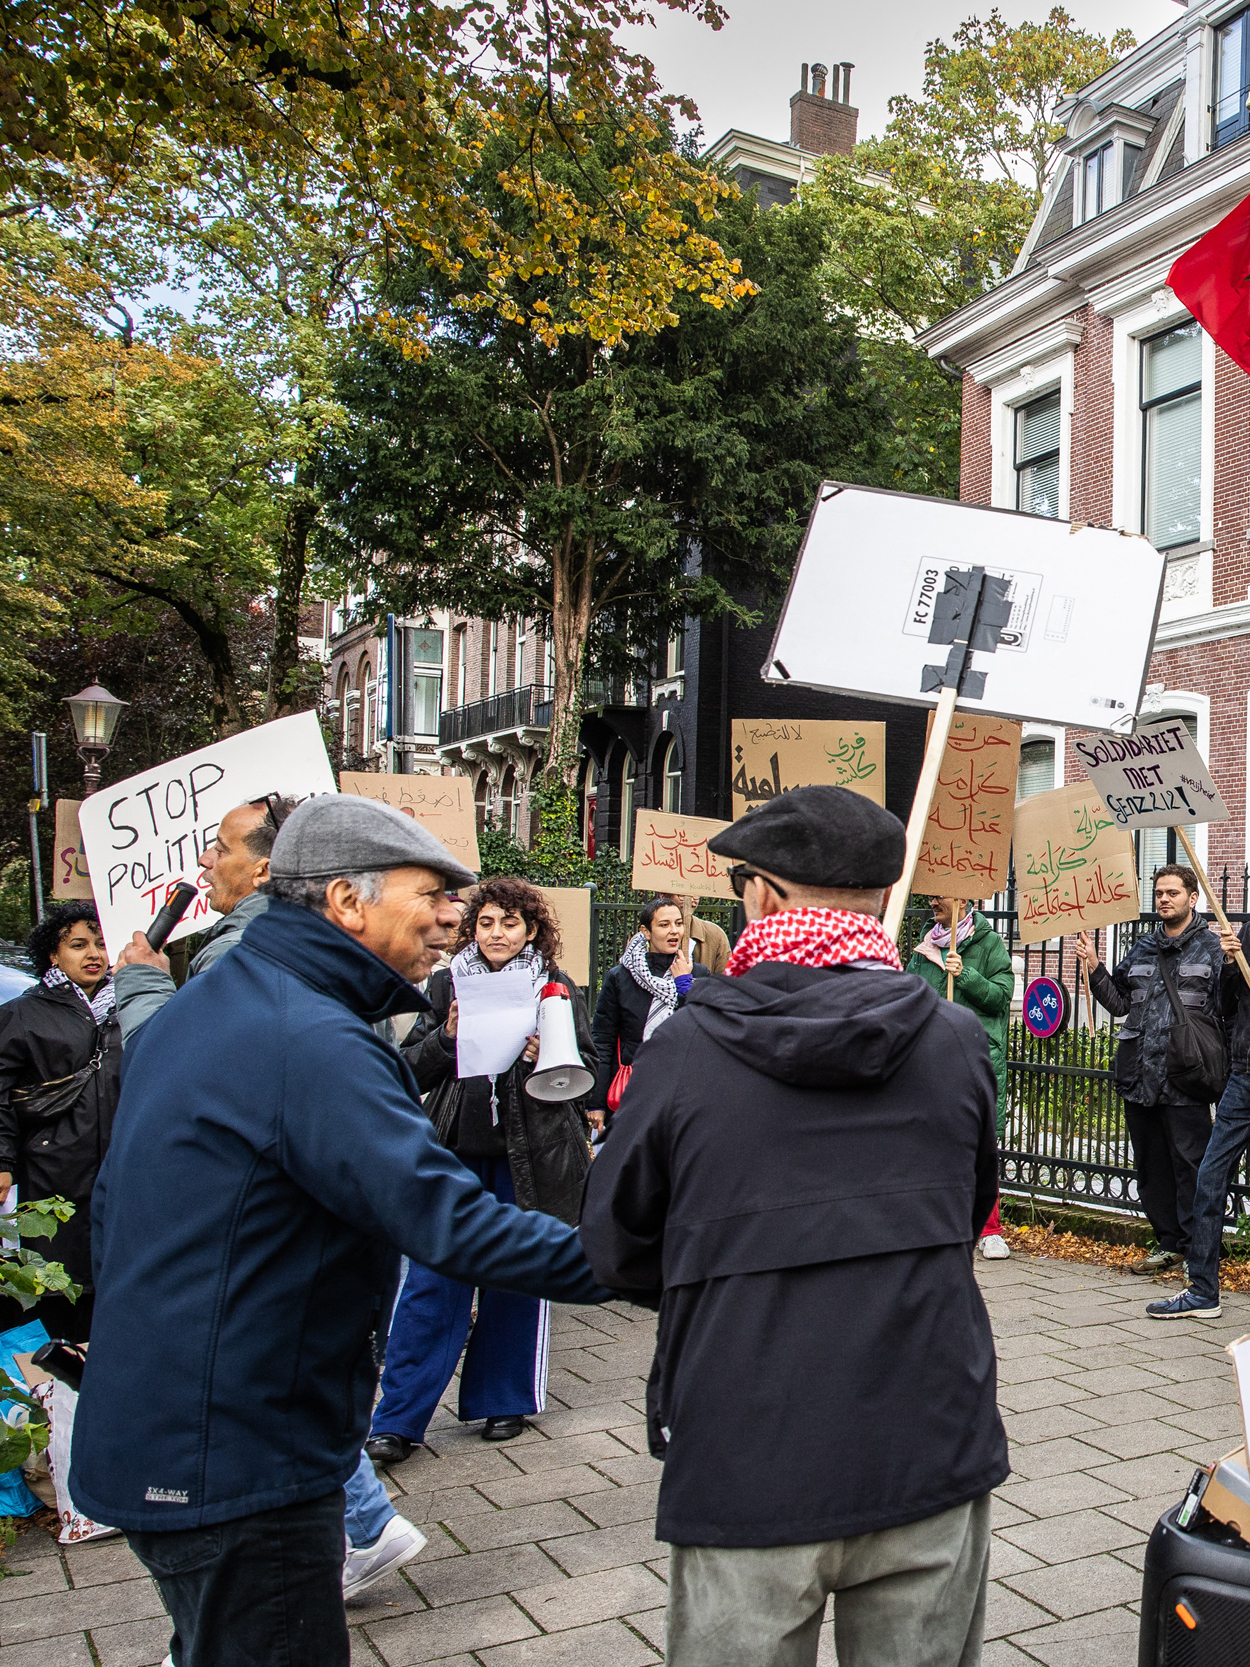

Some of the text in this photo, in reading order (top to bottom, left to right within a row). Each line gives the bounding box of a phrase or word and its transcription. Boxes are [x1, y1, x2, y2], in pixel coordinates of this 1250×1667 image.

[917, 568, 939, 609] 77003
[1122, 763, 1164, 790] MET
[107, 763, 226, 851] STOP
